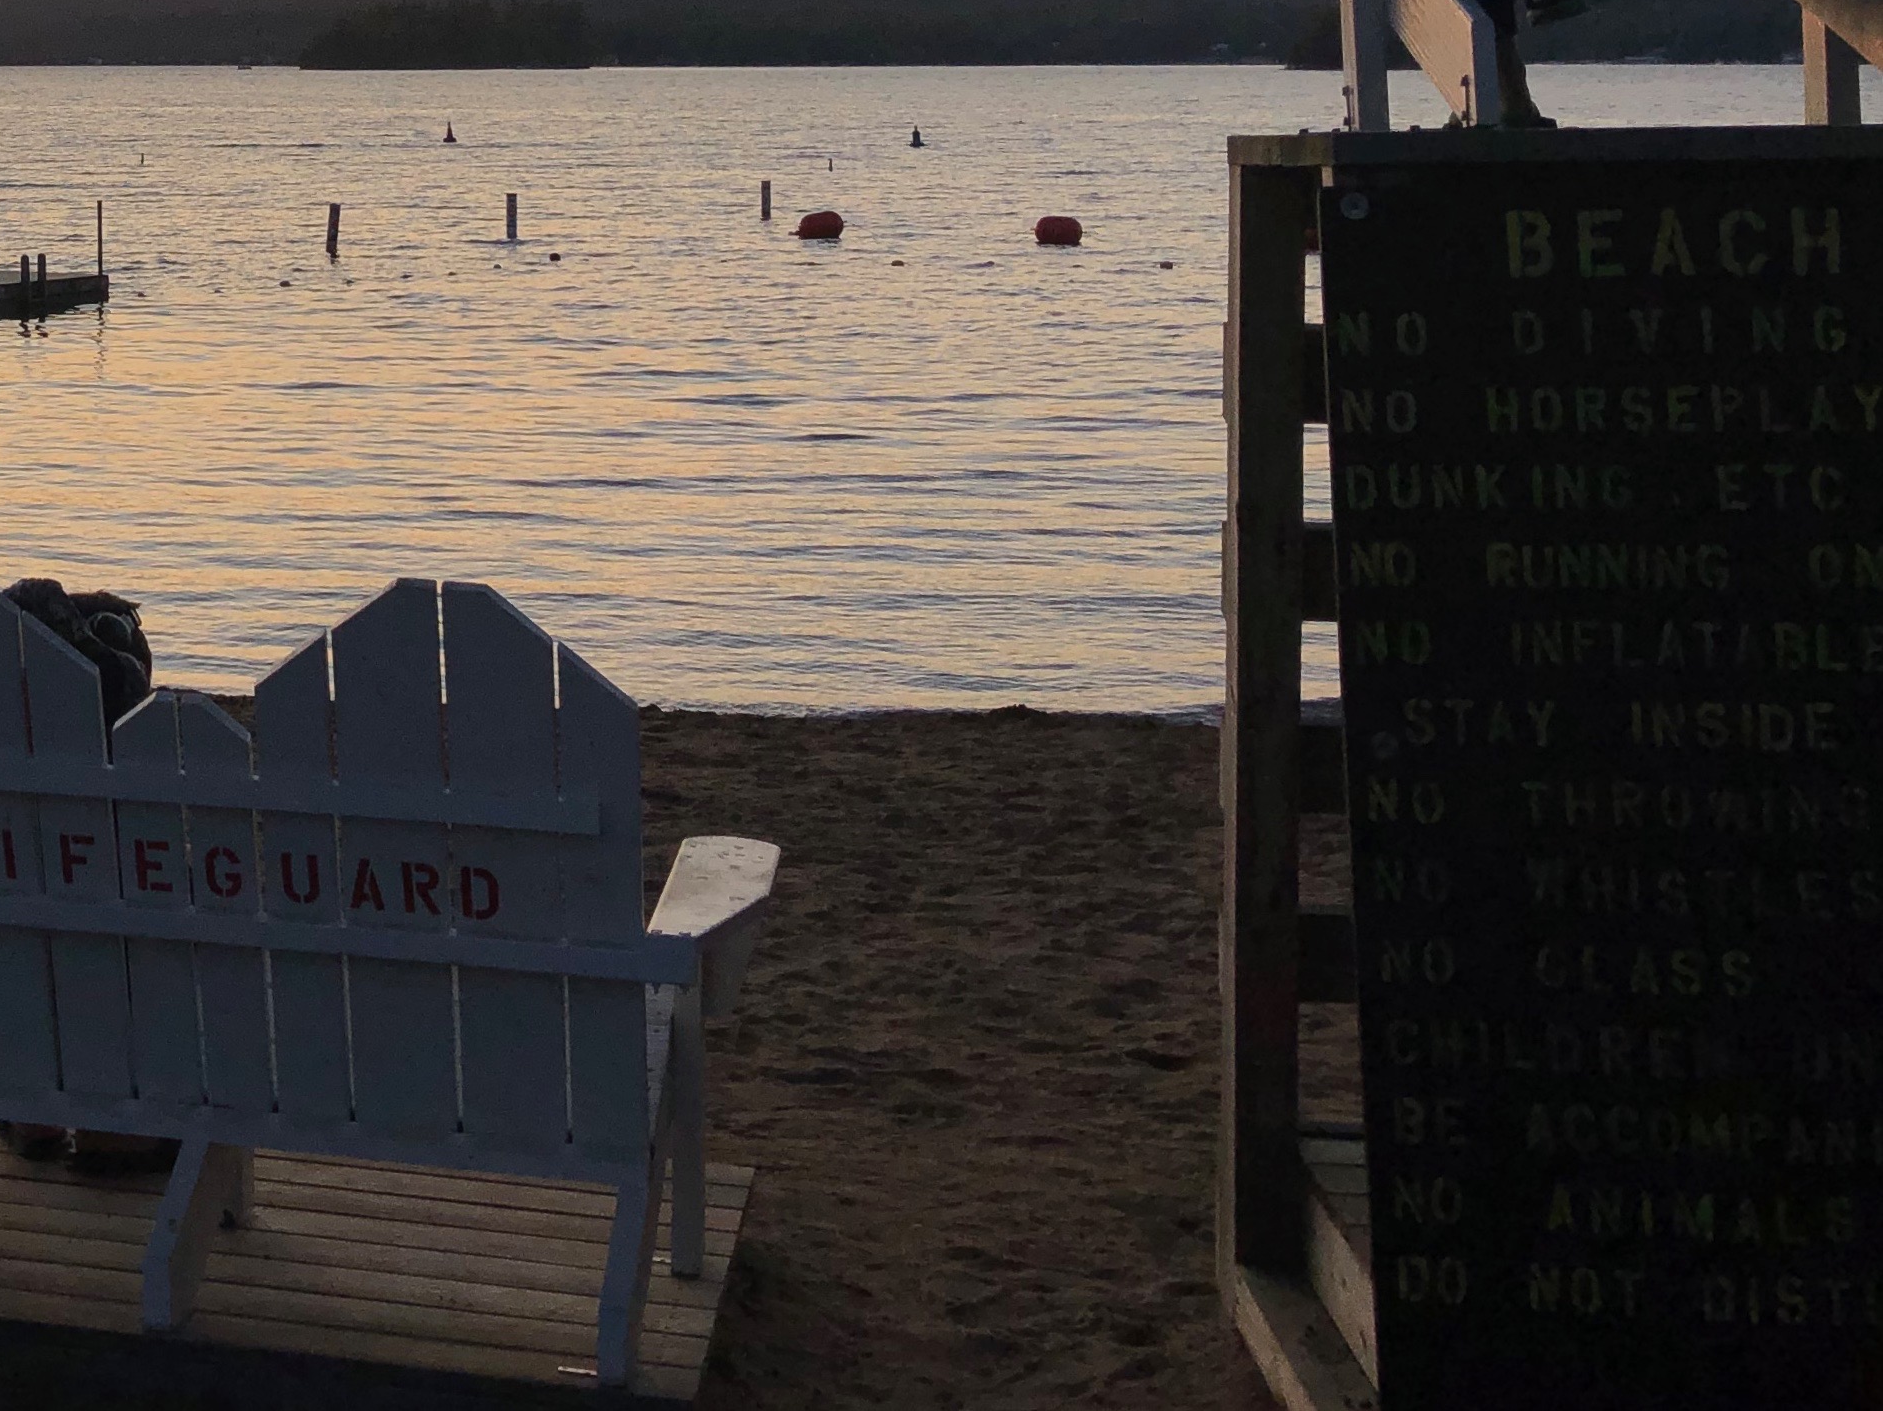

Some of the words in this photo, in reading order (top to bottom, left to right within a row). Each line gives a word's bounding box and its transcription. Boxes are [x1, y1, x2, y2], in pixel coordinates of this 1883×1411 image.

[1505, 206, 1843, 279] BEACH
[1336, 310, 1428, 357] NO
[1512, 305, 1849, 356] DIVING
[1341, 389, 1419, 435] NO
[1485, 384, 1883, 435] HORSEPLAY
[1716, 463, 1846, 513] ETC
[1350, 540, 1418, 589] NO
[1485, 541, 1732, 592] RUNNING
[1354, 620, 1433, 668] NO
[1403, 698, 1557, 749] STAY
[1629, 700, 1839, 754] INSIDE
[1366, 777, 1446, 826] NO
[1521, 780, 1871, 833] THROWING
[1372, 858, 1452, 904] NO
[1526, 858, 1882, 921] WHISTLES
[1379, 937, 1456, 986] NO
[1393, 1096, 1467, 1148] BE
[1393, 1176, 1464, 1225] NO
[1545, 1182, 1857, 1245] ANIMALS
[1395, 1255, 1468, 1308] DO
[1528, 1262, 1644, 1320] NOT
